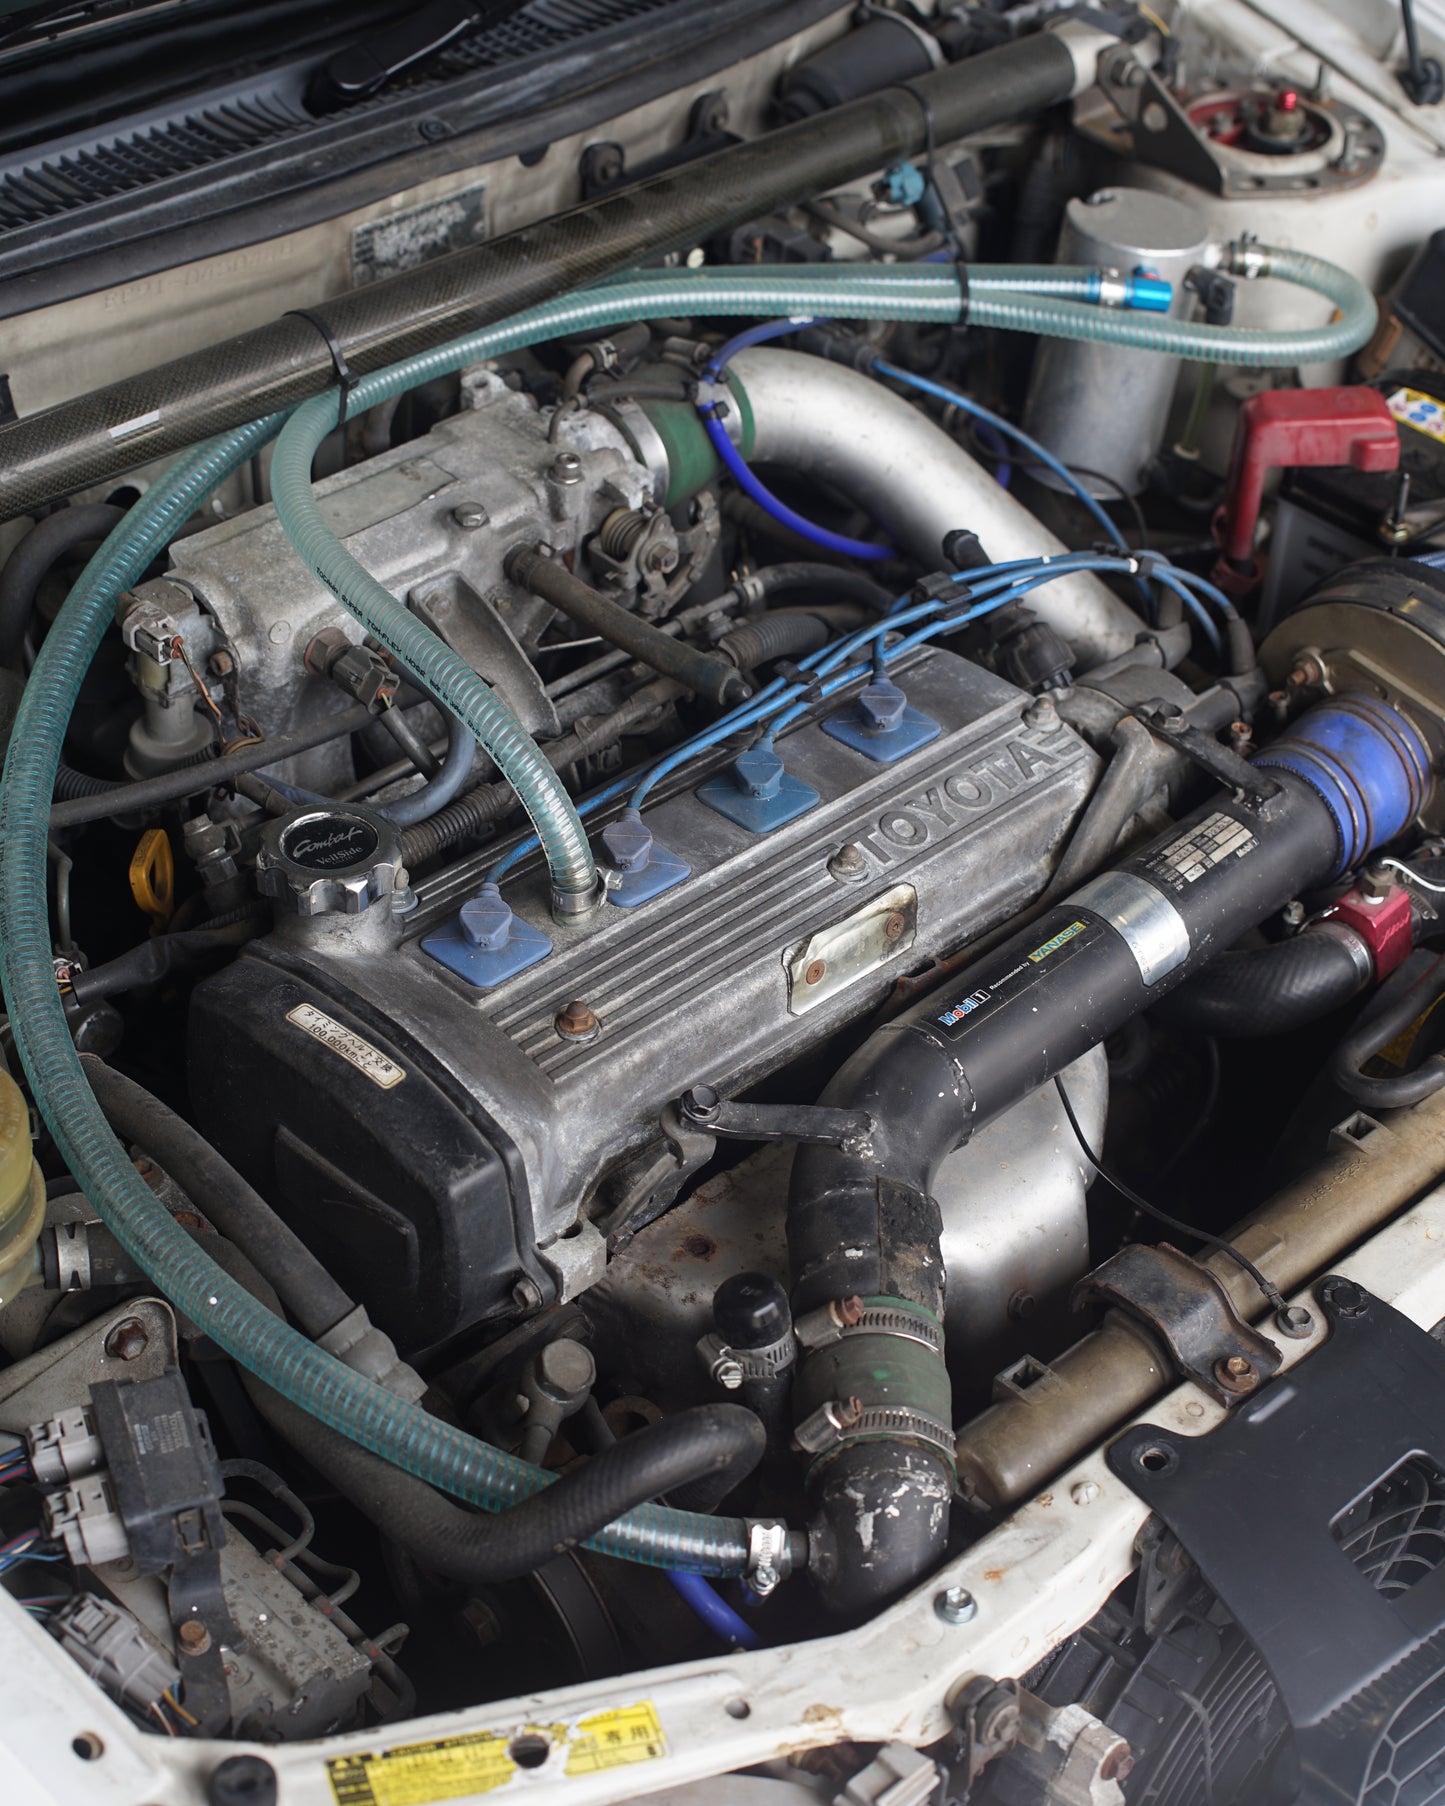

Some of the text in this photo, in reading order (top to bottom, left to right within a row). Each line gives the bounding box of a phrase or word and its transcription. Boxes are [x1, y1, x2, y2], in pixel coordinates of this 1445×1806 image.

[341, 594, 363, 617] SUPER
[841, 740, 1060, 865] TOYOTA
[316, 846, 362, 865] VeilSide
[938, 997, 980, 1026] Mobil
[1032, 923, 1083, 959] YANASE
